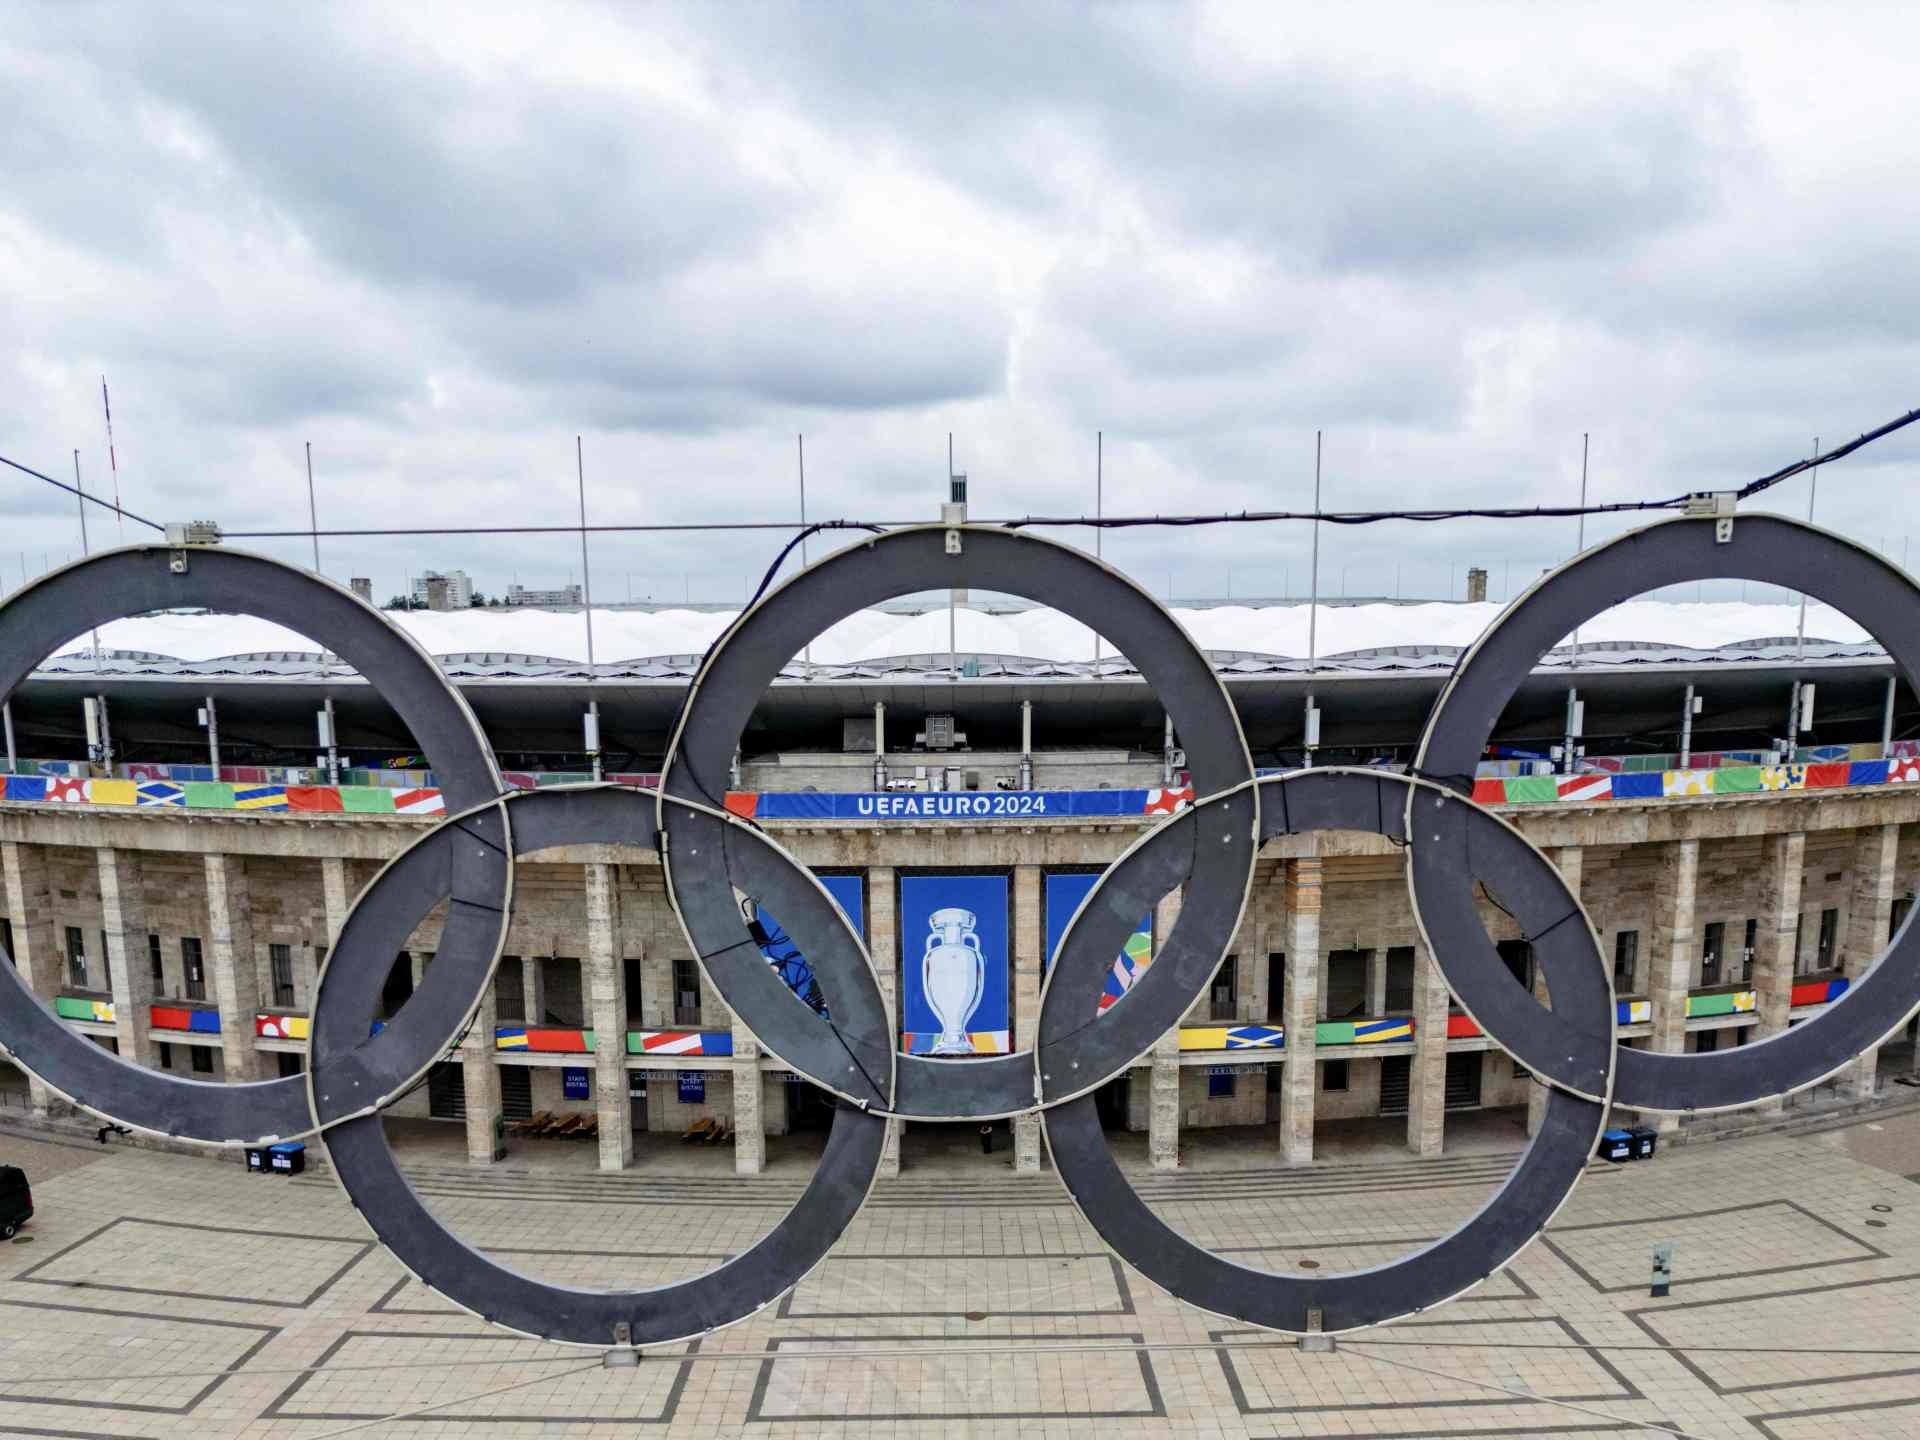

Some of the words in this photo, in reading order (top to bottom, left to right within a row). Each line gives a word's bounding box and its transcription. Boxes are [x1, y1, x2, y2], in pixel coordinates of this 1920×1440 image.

[858, 797, 919, 815] UEFA
[922, 797, 991, 815] EURO
[993, 796, 1046, 814] 2024
